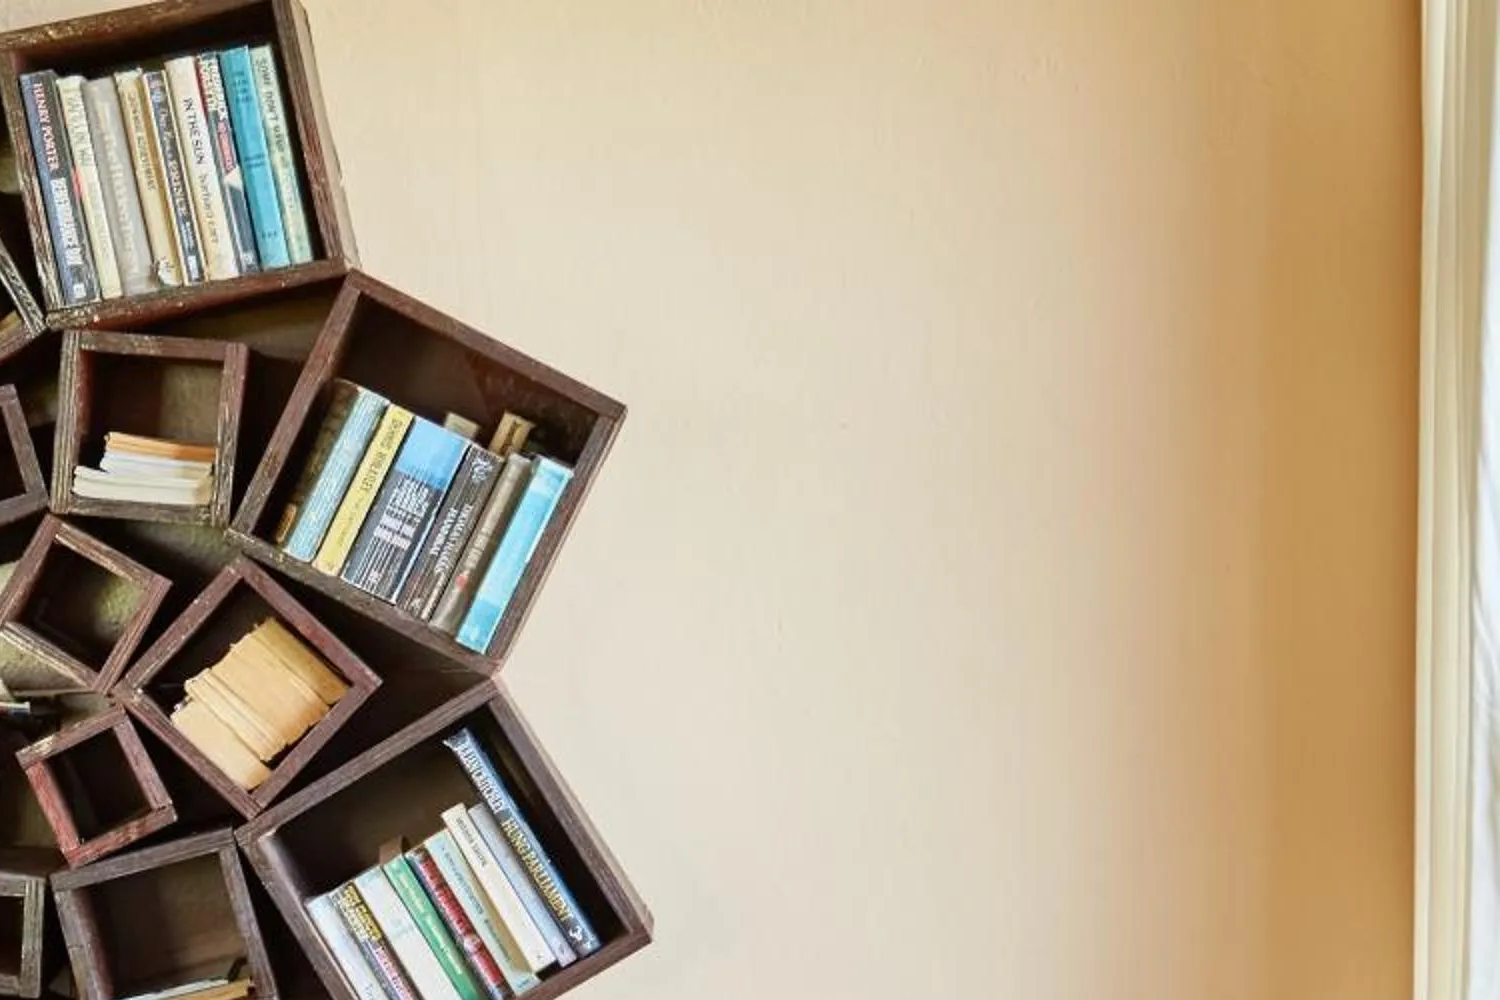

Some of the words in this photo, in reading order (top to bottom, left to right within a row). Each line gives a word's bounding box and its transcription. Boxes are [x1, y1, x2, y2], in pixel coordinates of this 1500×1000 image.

[30, 81, 50, 124] HENRY
[40, 125, 61, 172] PORTER
[185, 114, 201, 139] THE
[190, 139, 206, 165] SUN
[499, 816, 532, 855] HUNG
[520, 850, 574, 923] PARLIAMENT
